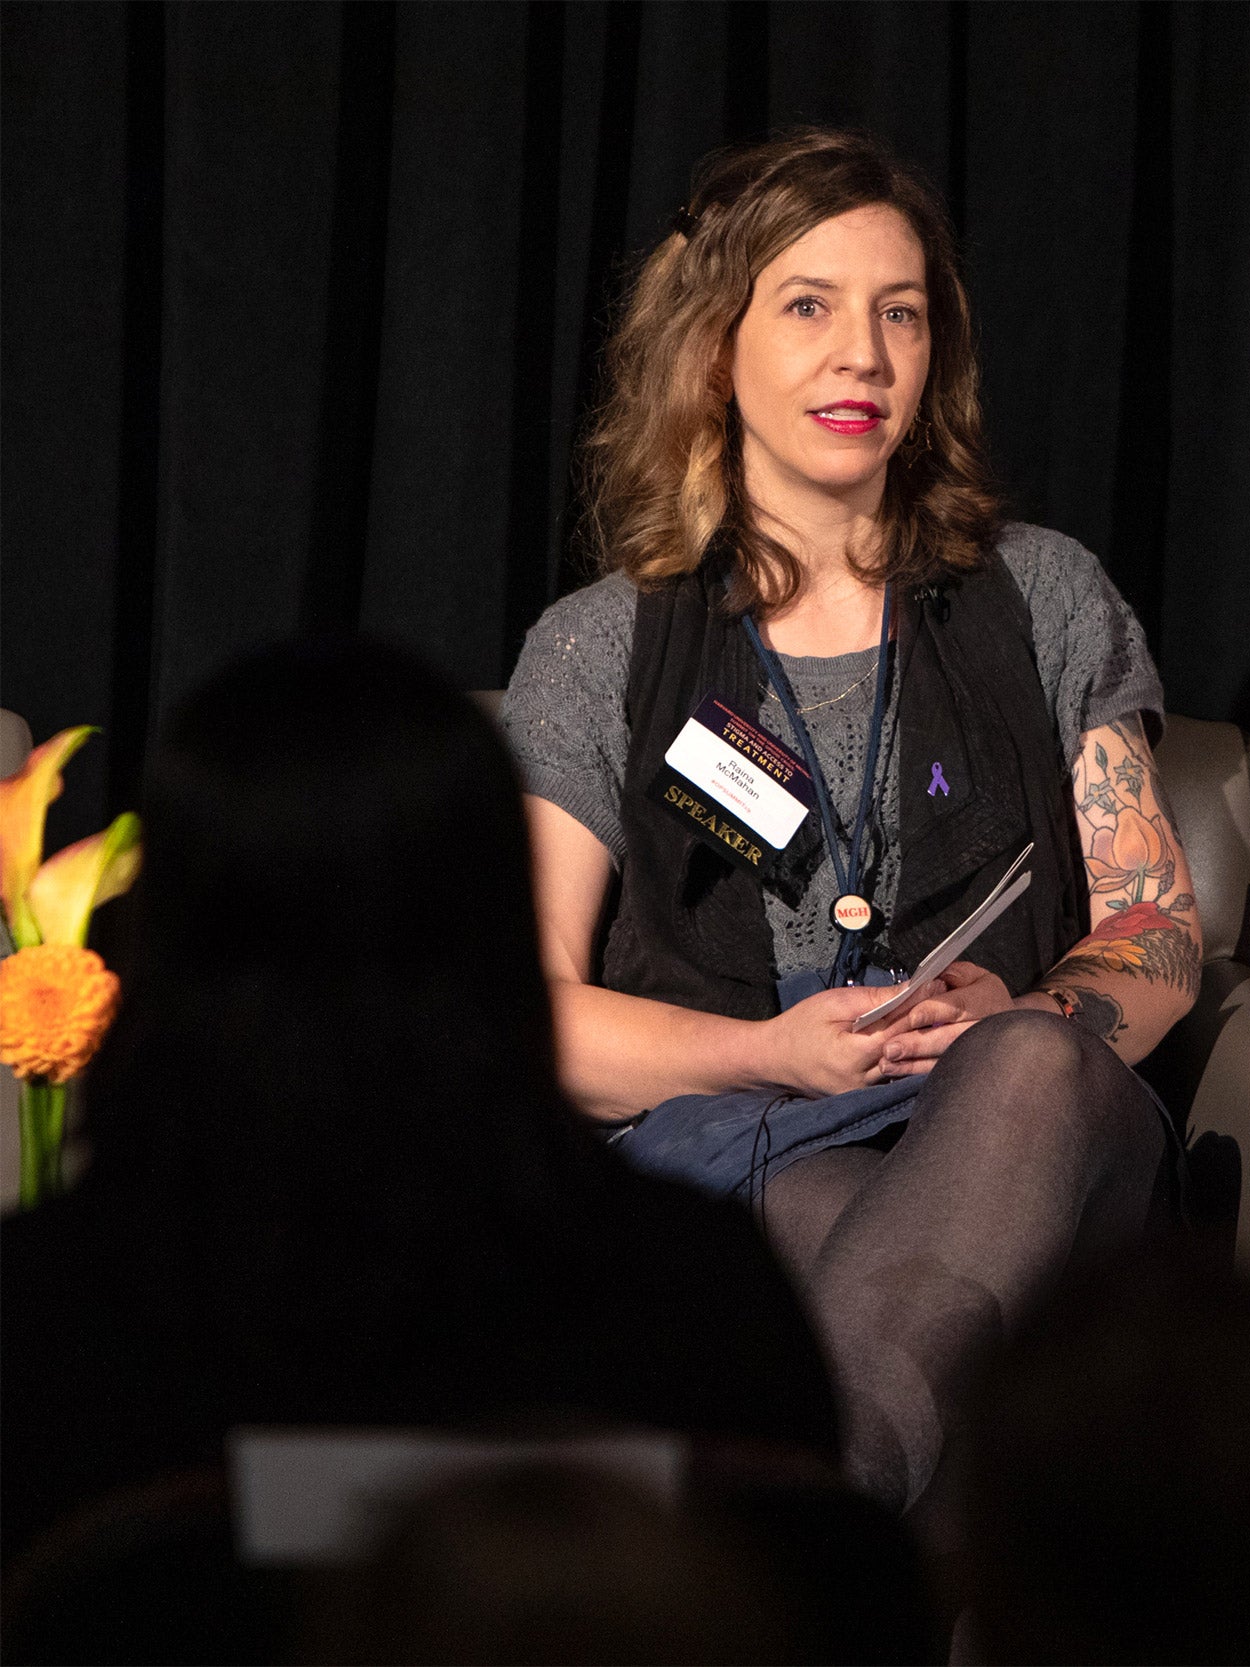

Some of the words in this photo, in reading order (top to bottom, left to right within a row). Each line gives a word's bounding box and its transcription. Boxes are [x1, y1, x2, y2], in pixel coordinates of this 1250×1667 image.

[721, 727, 790, 784] TREATMENT
[725, 722, 750, 742] STIGMA
[747, 739, 763, 752] AND
[761, 750, 785, 769] ACCESS
[783, 767, 794, 777] TO
[727, 759, 755, 784] Raina
[715, 761, 760, 800] McMahan
[664, 785, 763, 866] SPEAKER
[837, 907, 868, 918] MGH
